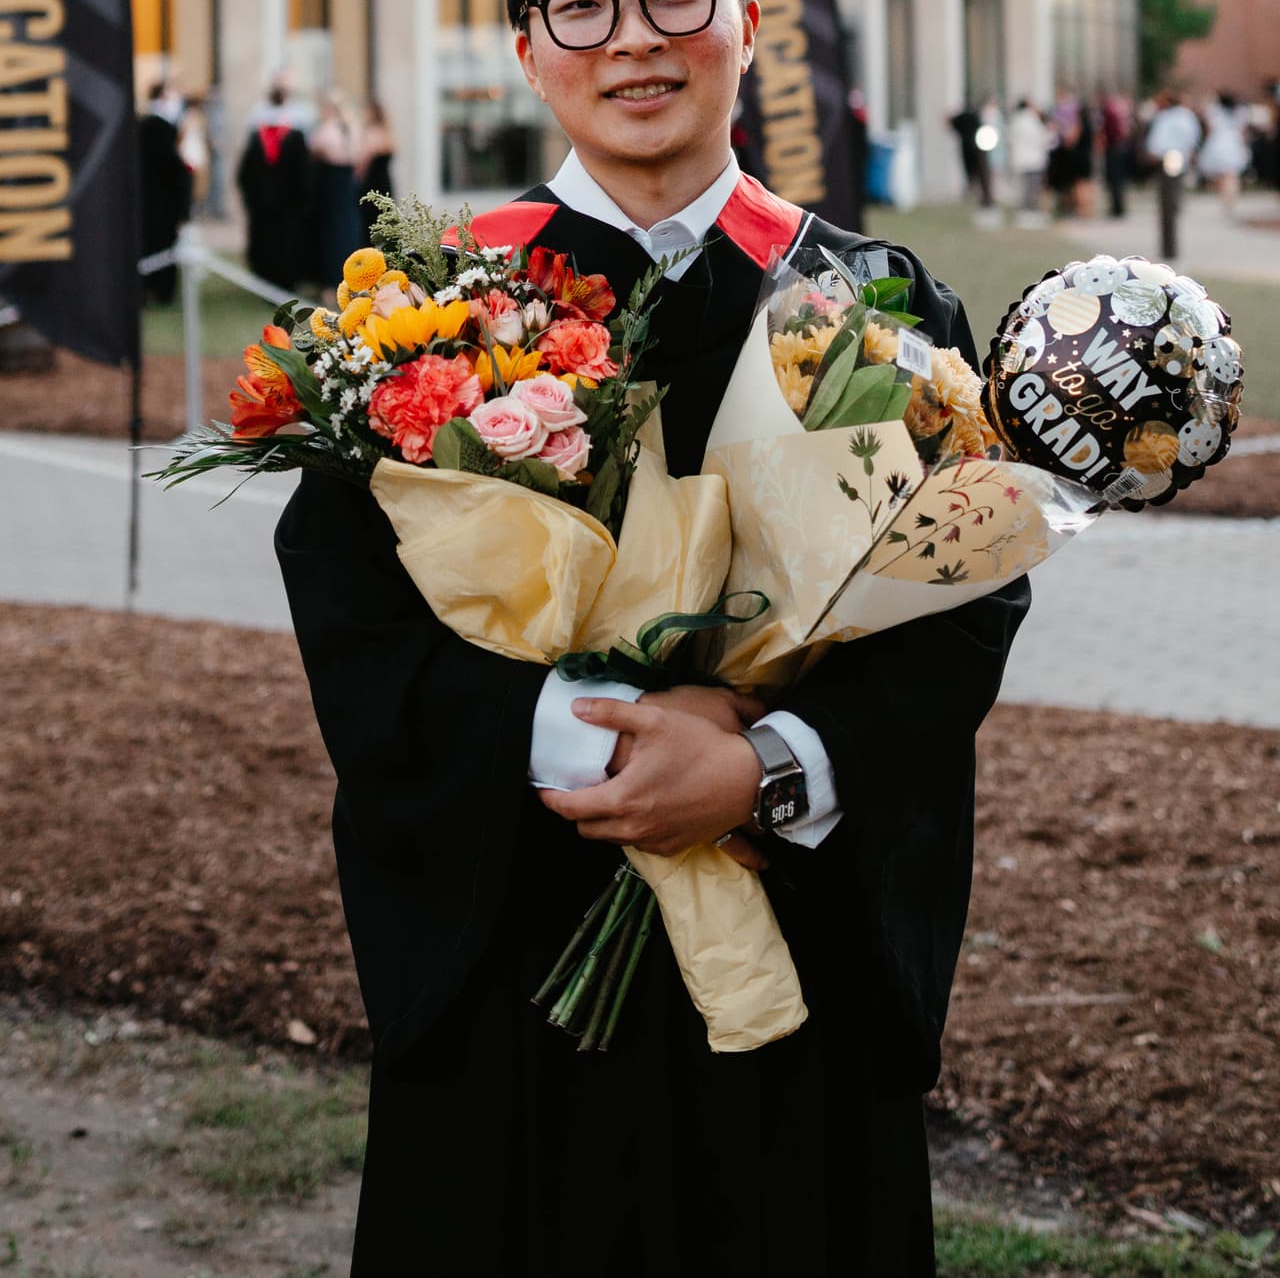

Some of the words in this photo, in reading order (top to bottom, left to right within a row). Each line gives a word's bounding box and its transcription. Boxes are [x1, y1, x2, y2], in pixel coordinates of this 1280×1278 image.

[1052, 360, 1085, 397] to
[1081, 327, 1162, 411] WAY
[1009, 373, 1111, 483] GRAD!
[1064, 393, 1117, 431] go
[771, 800, 794, 823] 9:05
